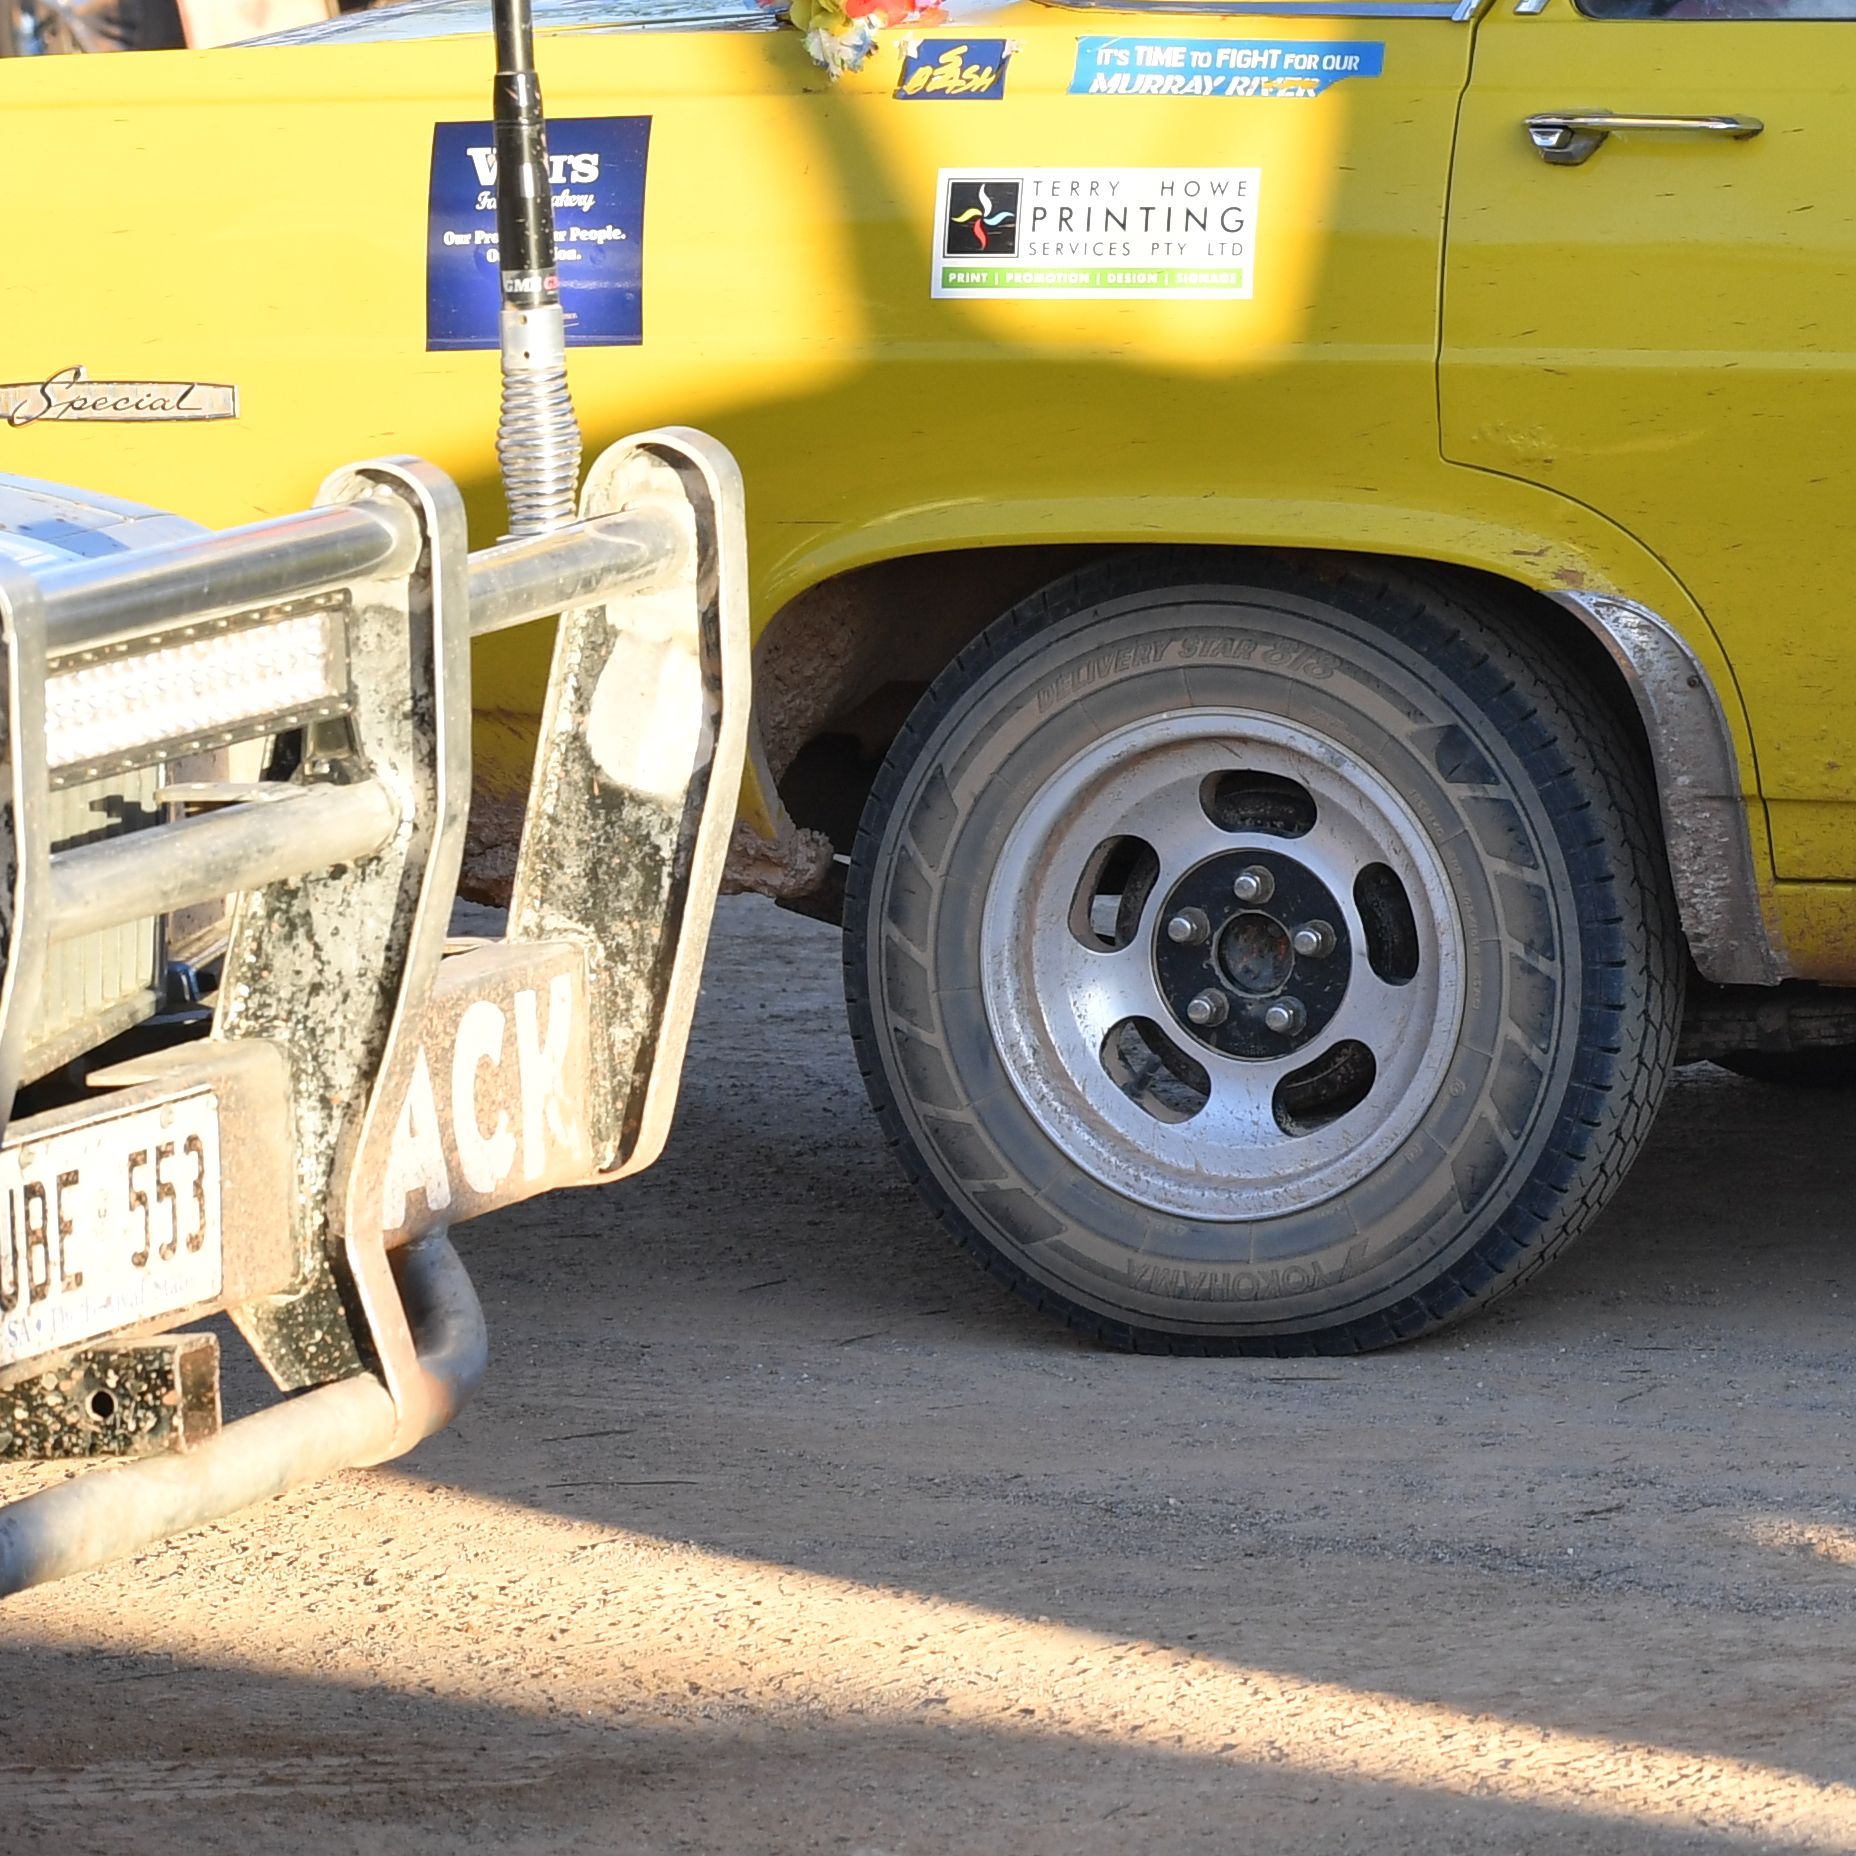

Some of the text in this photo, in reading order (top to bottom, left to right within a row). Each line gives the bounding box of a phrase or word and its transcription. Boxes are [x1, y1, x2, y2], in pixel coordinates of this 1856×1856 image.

[1096, 45, 1360, 71] IT'S TIME TO FIGHT FOR OUR
[1089, 72, 1320, 98] MURRAY RIVER
[1032, 180, 1248, 197] TERRY HOWE
[1031, 206, 1245, 233] PRINTING
[443, 231, 472, 246] Our
[569, 224, 627, 241] People.
[1028, 242, 1243, 257] SERVICES PTY LTD
[948, 272, 988, 284] PRINT
[1107, 272, 1158, 284] DESIGN
[8, 365, 203, 428] Special
[1036, 642, 1170, 715] DELIVERY
[1178, 637, 1258, 660] STAR
[128, 1133, 207, 1268] 553
[1127, 1258, 1331, 1303] YOKOHAMA
